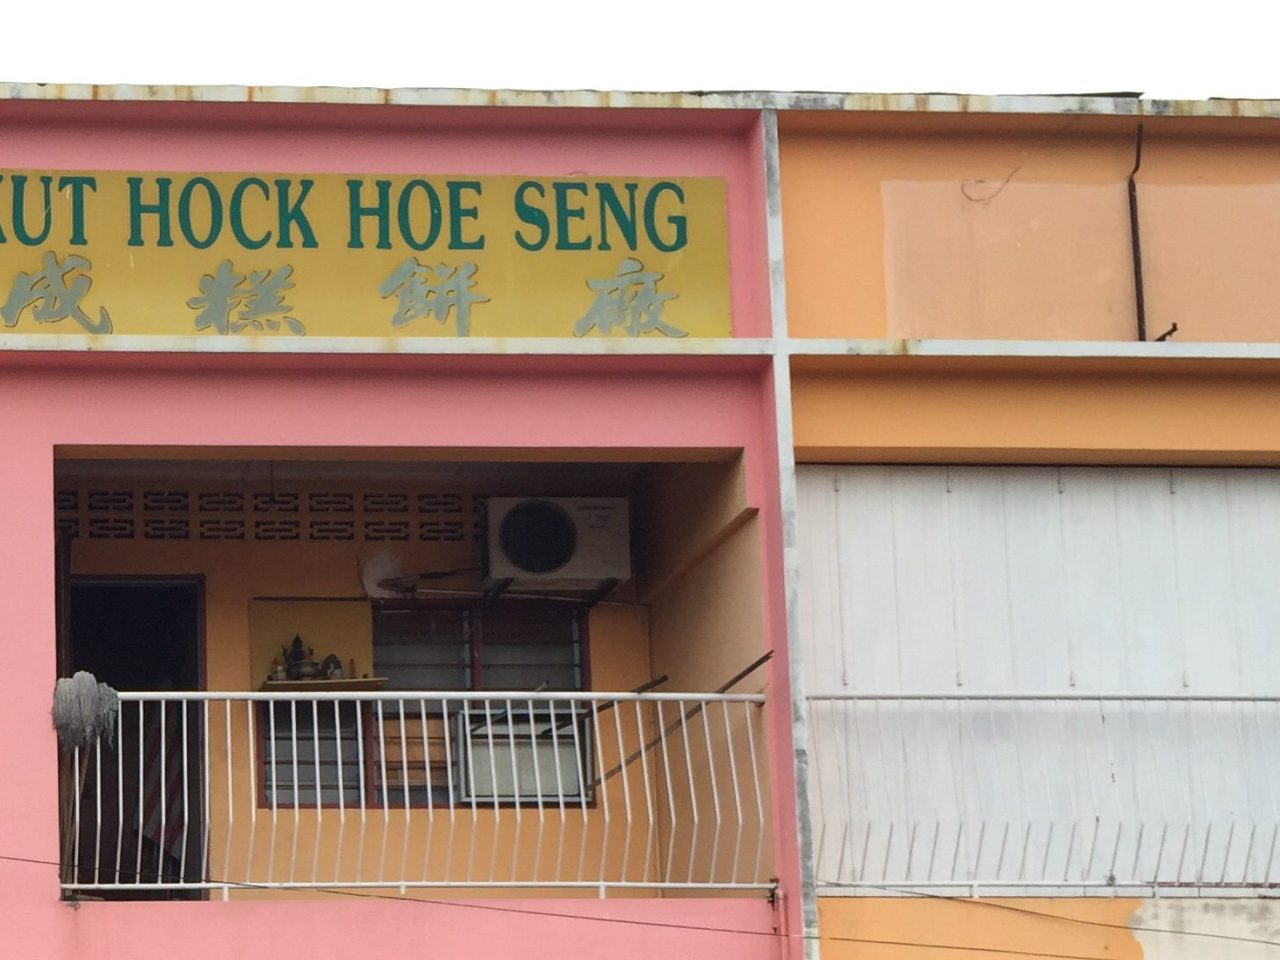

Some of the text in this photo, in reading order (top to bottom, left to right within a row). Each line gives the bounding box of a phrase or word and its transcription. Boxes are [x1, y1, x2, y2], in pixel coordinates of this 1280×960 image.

[127, 177, 319, 250] HOCK
[347, 179, 485, 250] HOE
[514, 181, 688, 252] SENG
